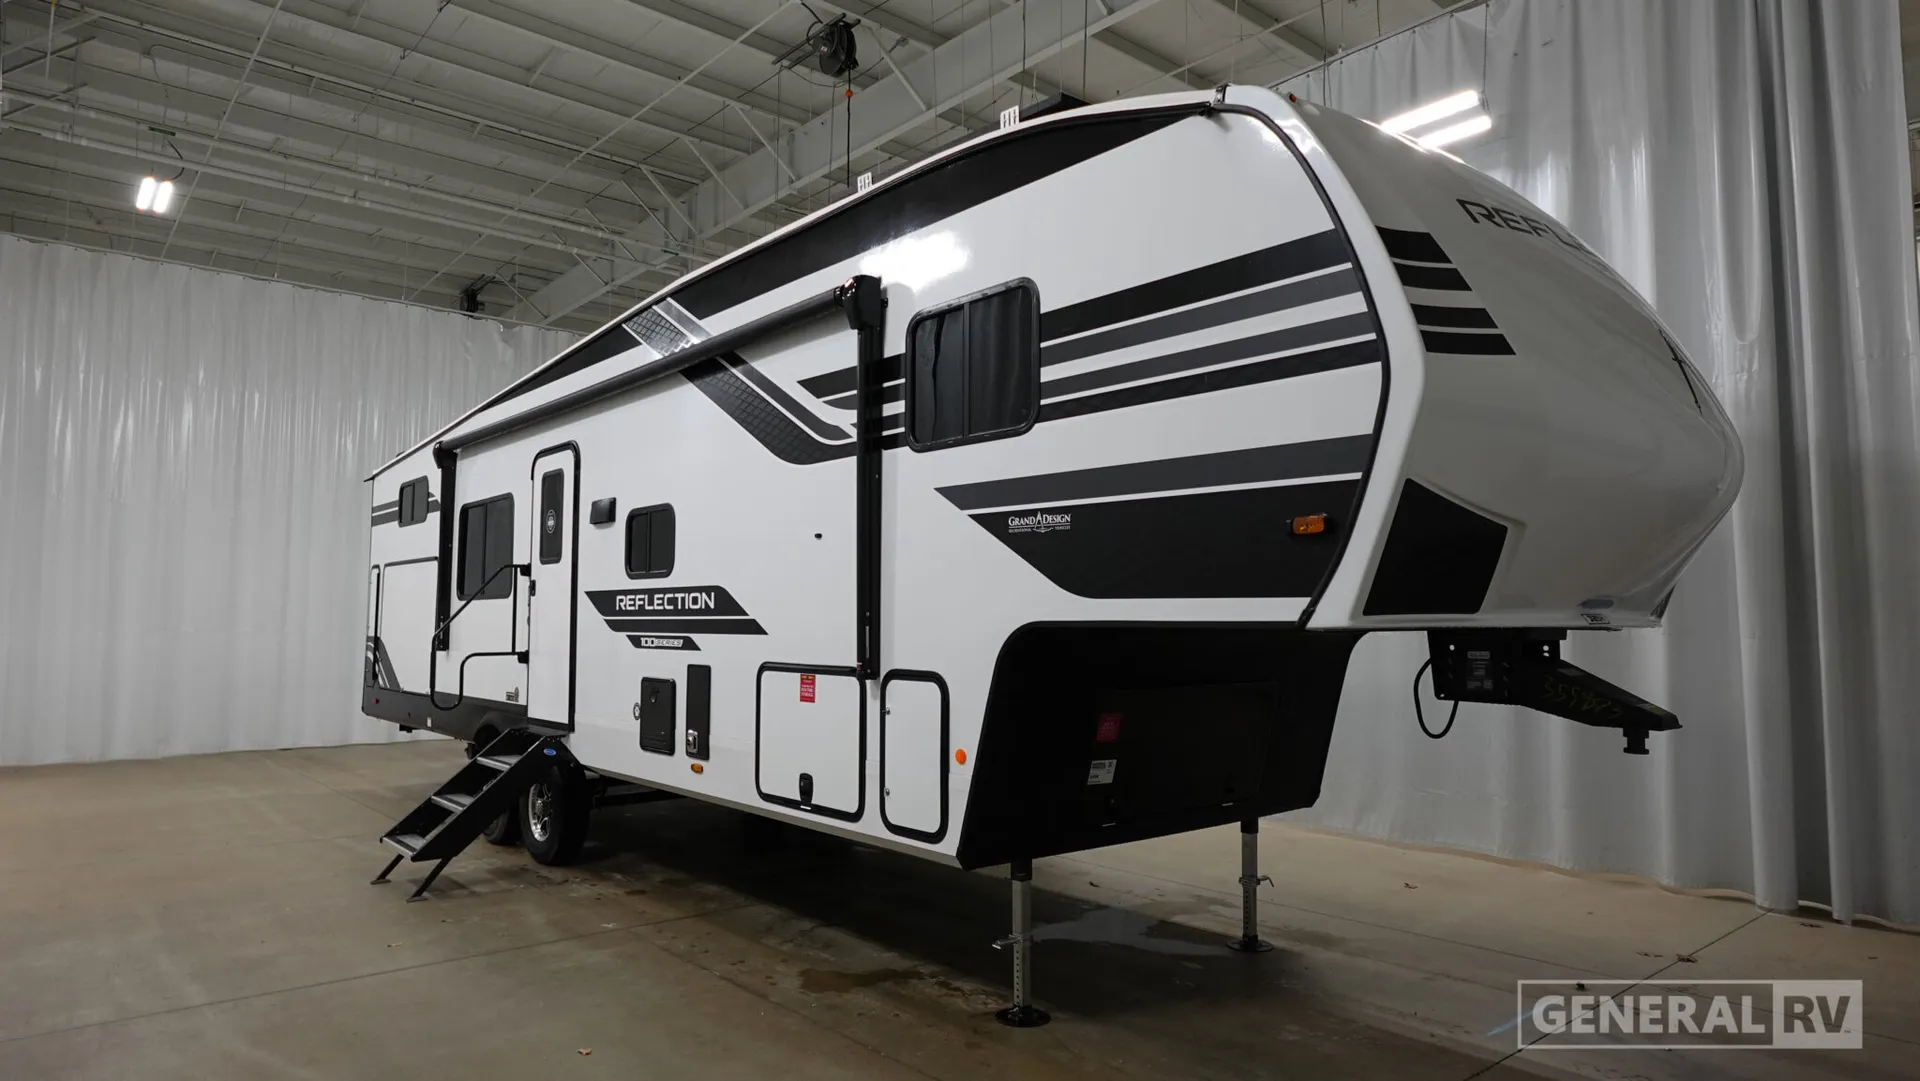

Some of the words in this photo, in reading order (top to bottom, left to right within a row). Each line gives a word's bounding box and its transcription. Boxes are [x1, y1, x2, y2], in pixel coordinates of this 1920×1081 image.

[1008, 516, 1036, 526] GRAND
[1042, 513, 1072, 524] DESIGN
[616, 592, 715, 610] REFLECTION
